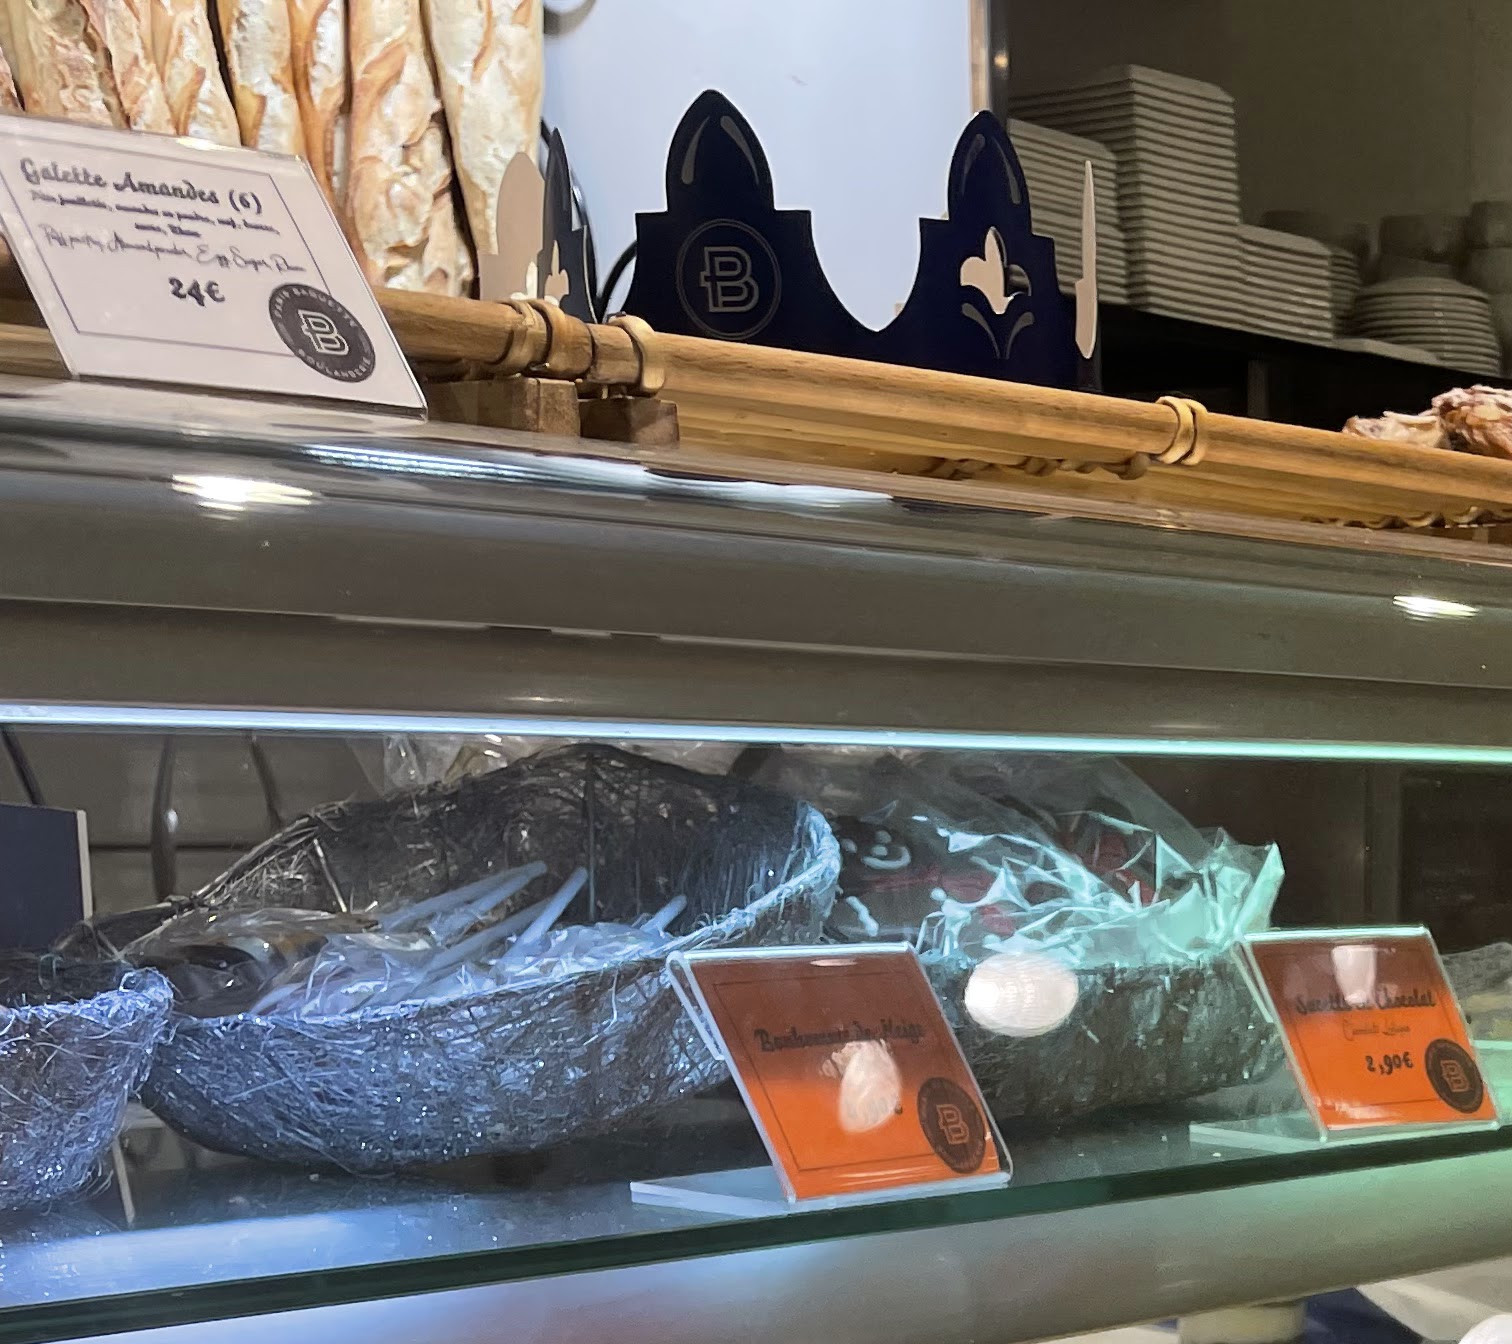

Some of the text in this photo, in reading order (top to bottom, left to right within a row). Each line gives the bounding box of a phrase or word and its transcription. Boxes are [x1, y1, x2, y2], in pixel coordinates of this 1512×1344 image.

[20, 158, 107, 188] Galette
[113, 172, 220, 204] Amandes
[229, 190, 262, 215] (6)
[169, 277, 226, 307] 24€
